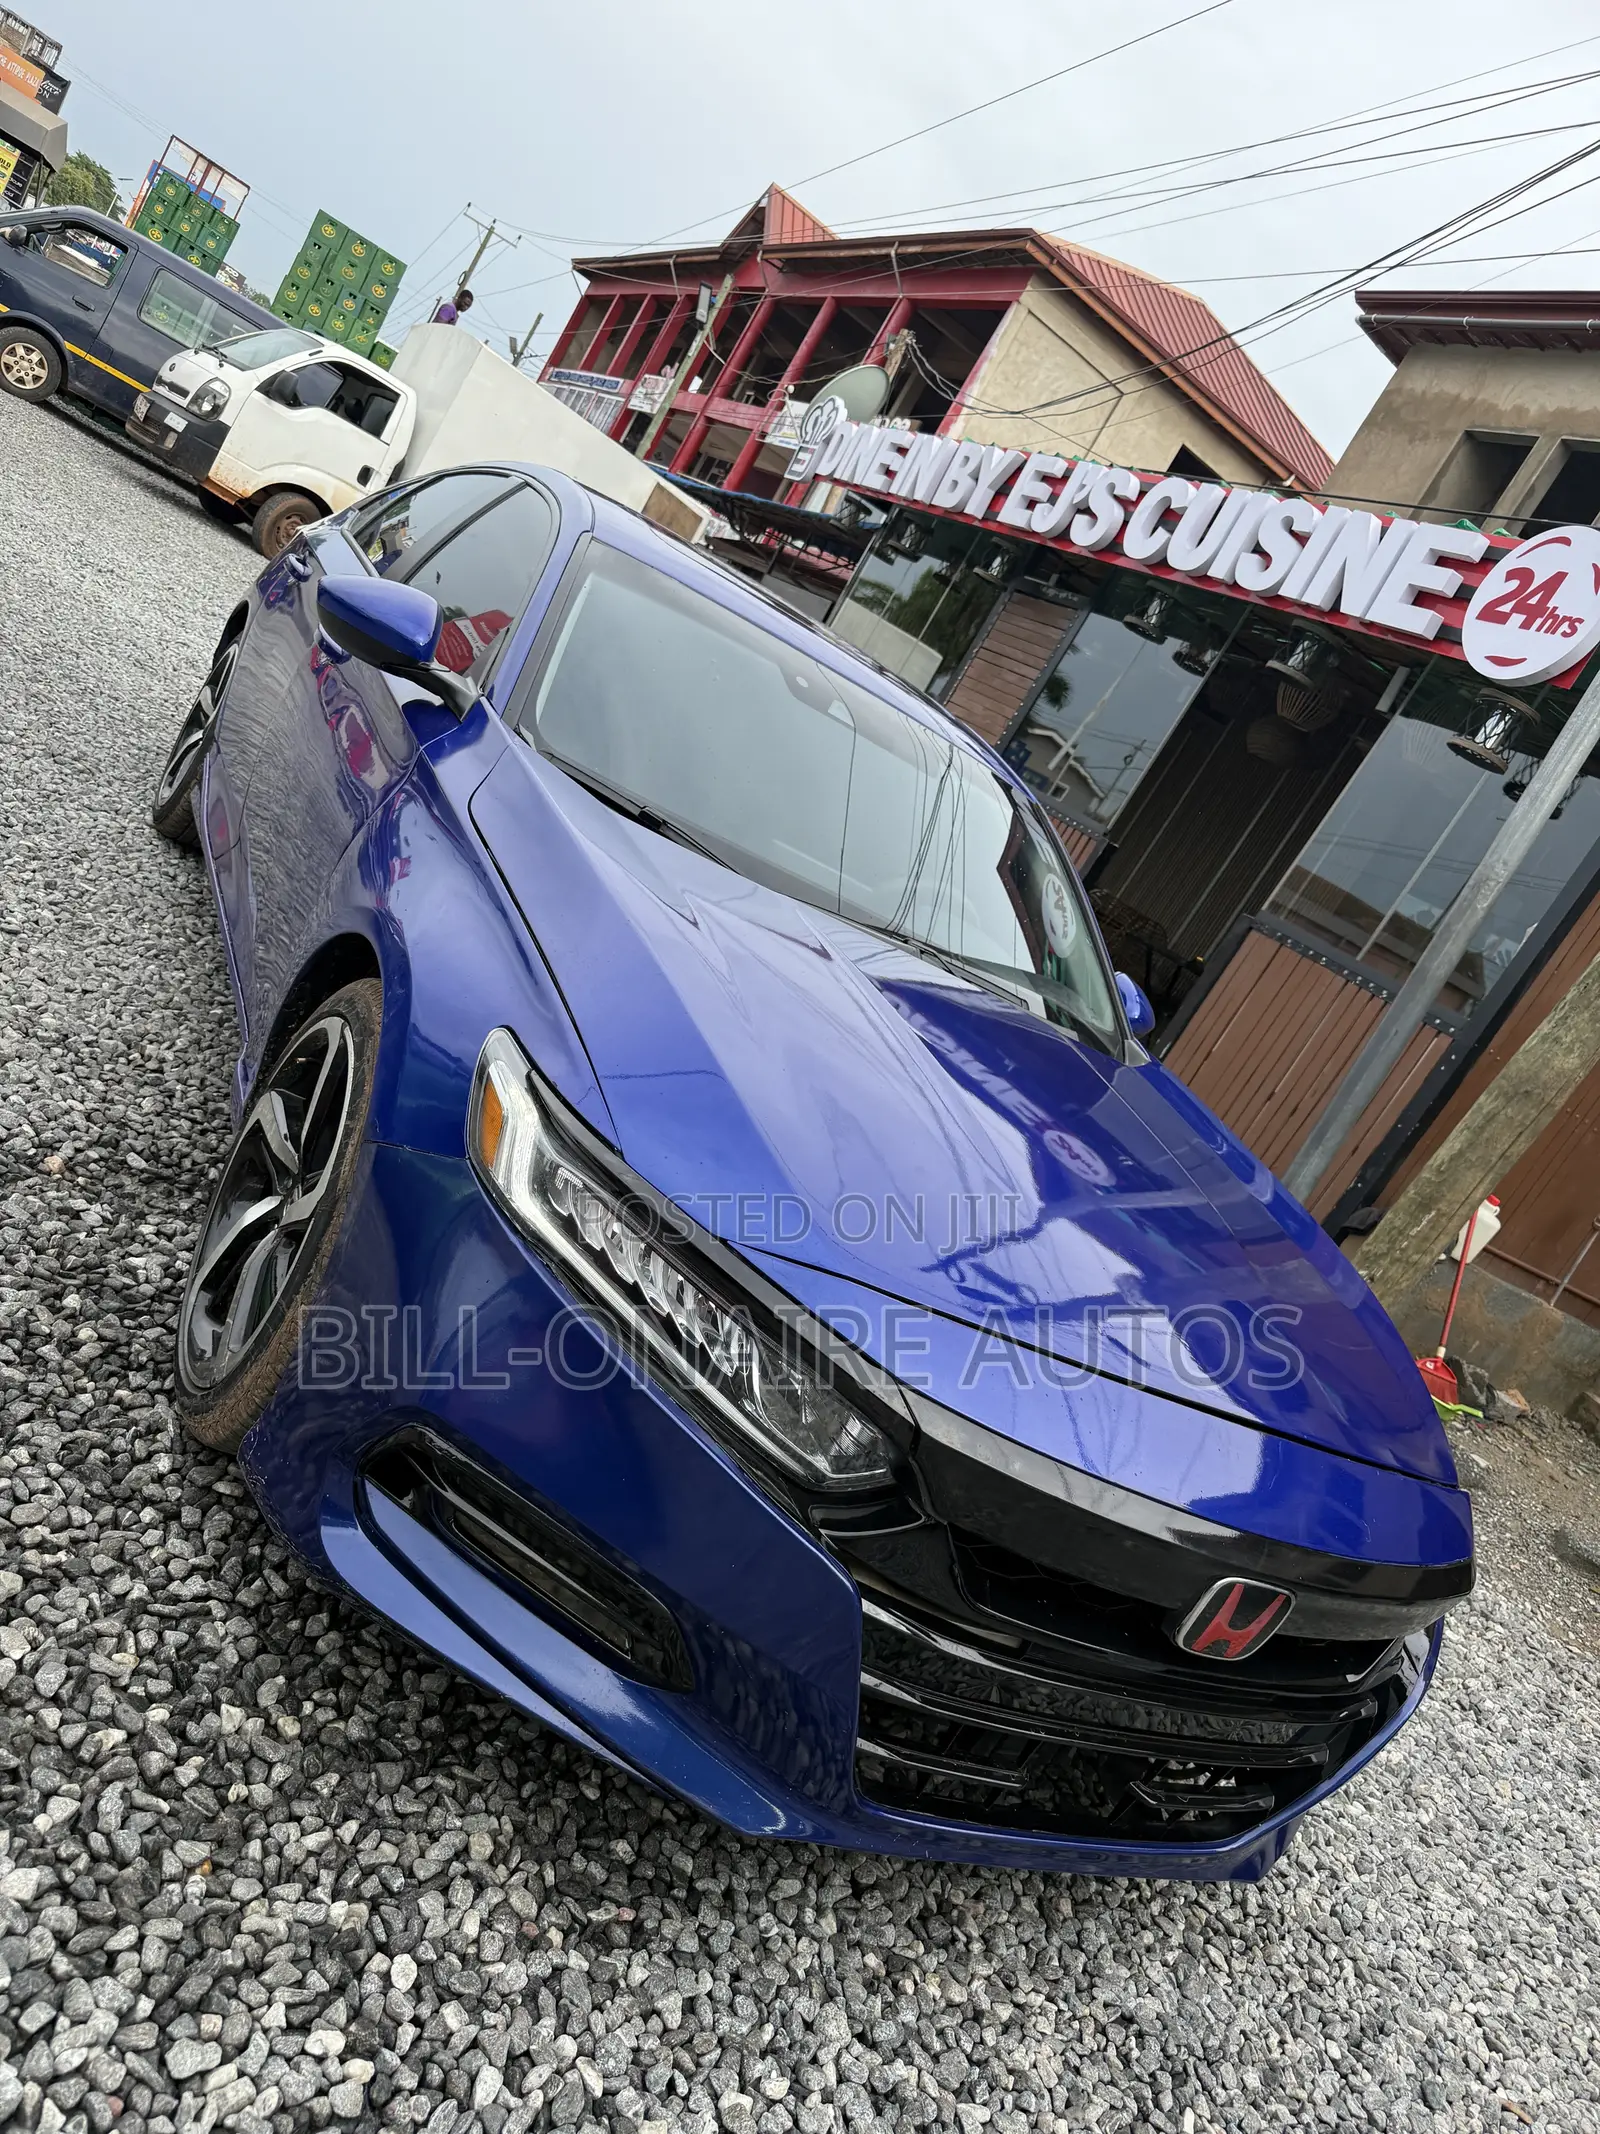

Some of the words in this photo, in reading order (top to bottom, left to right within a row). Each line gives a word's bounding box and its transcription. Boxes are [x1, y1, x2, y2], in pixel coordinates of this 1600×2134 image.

[931, 440, 1027, 520] BY
[996, 452, 1141, 551] EJ'S
[1122, 477, 1490, 641] CUISINE
